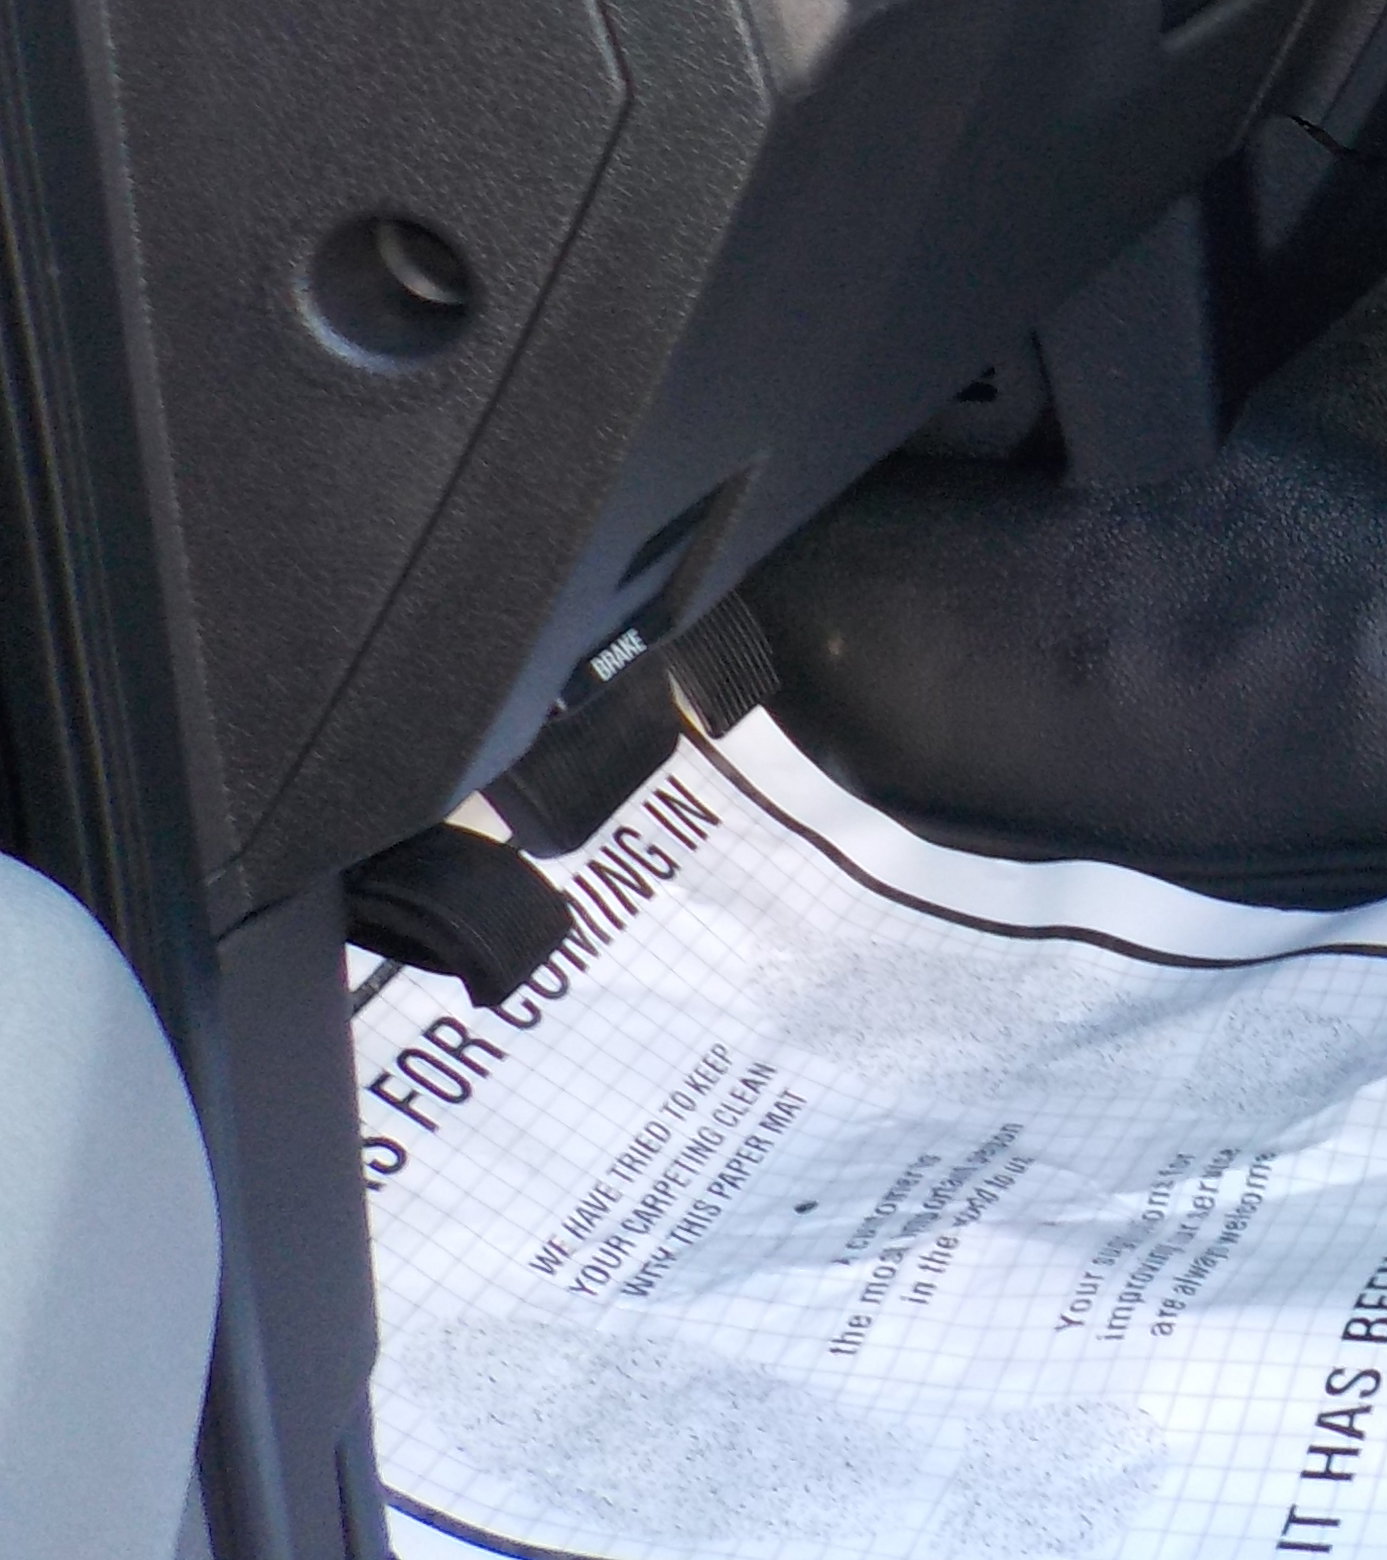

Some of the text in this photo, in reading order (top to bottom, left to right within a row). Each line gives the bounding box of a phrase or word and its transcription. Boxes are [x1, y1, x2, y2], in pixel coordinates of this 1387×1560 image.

[590, 627, 648, 682] BRAKE
[367, 1015, 508, 1134] FOR
[644, 775, 723, 851] IN
[529, 1042, 733, 1277] WE HAVE TRIED TO KEEP
[568, 1062, 779, 1297] YOUR CARPETING CLEAN
[666, 1198, 722, 1245] THIS
[707, 1134, 775, 1201] PAPER
[758, 1087, 808, 1135] MAT
[845, 1169, 924, 1251] cutomer
[900, 1281, 938, 1306] in
[918, 1235, 960, 1274] the
[1150, 1297, 1187, 1338] are
[1173, 1244, 1231, 1297] alway
[829, 1314, 873, 1356] the
[1054, 1270, 1106, 1333] Your
[1299, 1366, 1383, 1485] HAS
[1276, 1504, 1341, 1555] IT
